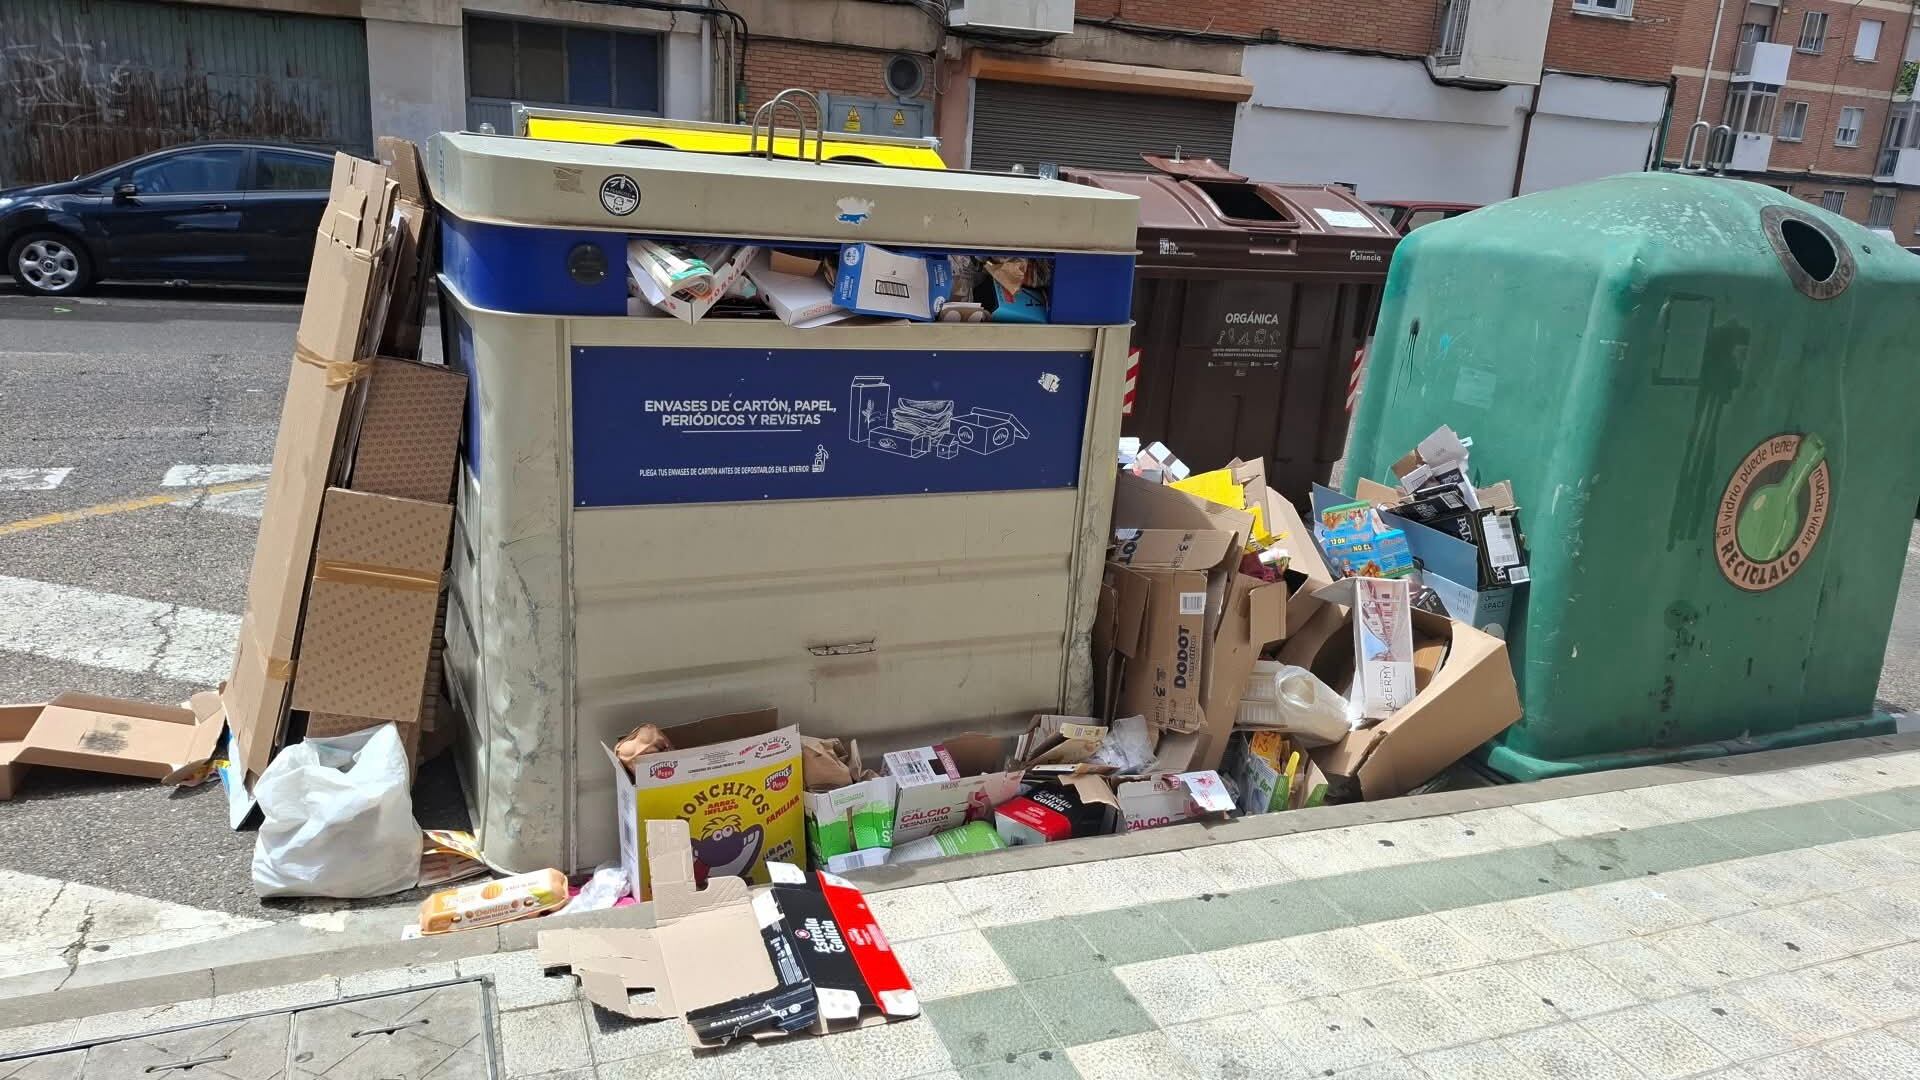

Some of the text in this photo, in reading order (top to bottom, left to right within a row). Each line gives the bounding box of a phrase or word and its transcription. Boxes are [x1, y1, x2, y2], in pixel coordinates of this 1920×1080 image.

[1350, 250, 1381, 260] Palencia
[1225, 311, 1279, 324] ORGÁNICA
[644, 398, 837, 413] ENVASES DE CARTÓN, PAPEL,
[662, 412, 821, 426] PERIÓDICOS Y REVISTAS
[640, 469, 657, 477] PLIEGA
[658, 468, 668, 476] TUS
[668, 468, 690, 476] ENVASES
[718, 467, 734, 475] ANTES
[734, 467, 740, 475] DE
[775, 465, 782, 473] EN
[782, 465, 788, 473] EL
[788, 465, 809, 473] INTERIOR
[1722, 439, 1828, 547] el vidrio puede tener muchas vidas
[1721, 540, 1801, 585] RECICLALO
[1174, 625, 1190, 689] DODOT
[765, 764, 792, 788] SNACKS
[677, 782, 770, 821] ONCHITOS
[707, 799, 736, 809] ARROZ
[1033, 794, 1065, 812] Galicia
[1038, 790, 1073, 809] Estrella
[704, 804, 739, 816] INFLADO
[766, 794, 800, 825] FAMILIAR
[901, 806, 951, 823] CALCIO
[900, 814, 949, 830] DESNATADA
[1125, 816, 1170, 832] CALCIO
[804, 917, 832, 954] Estrella
[821, 920, 847, 953] Galicia
